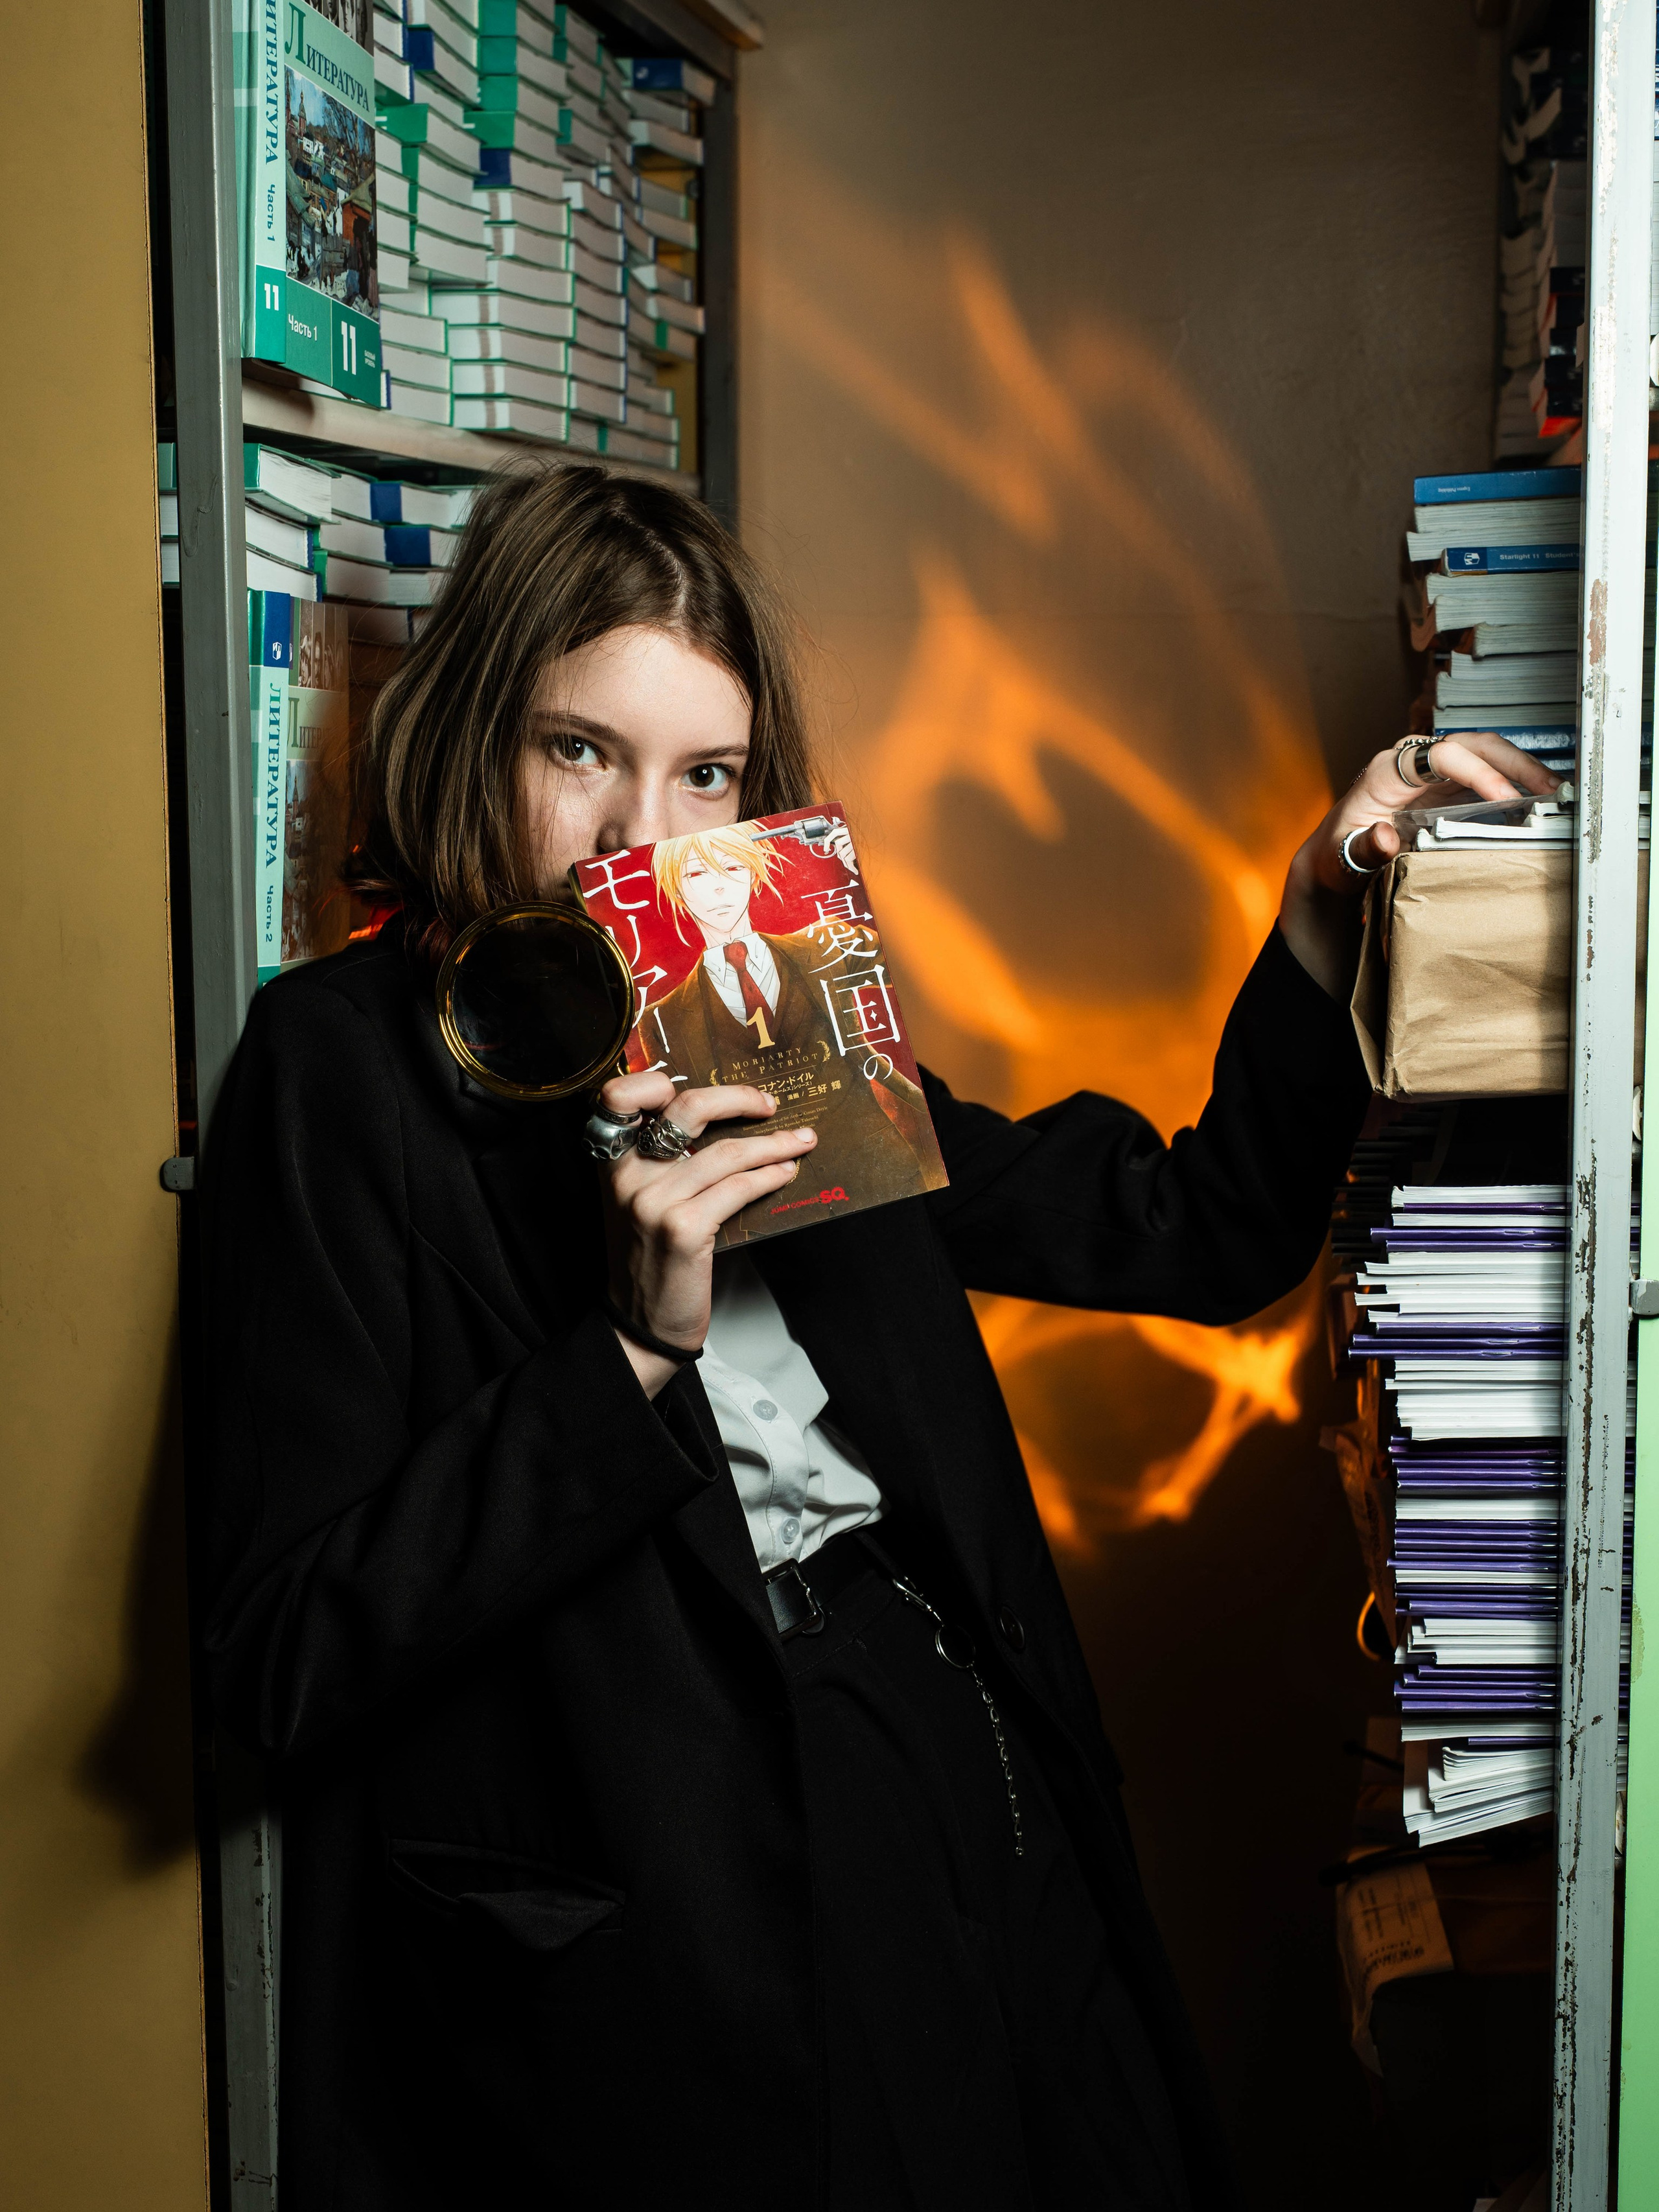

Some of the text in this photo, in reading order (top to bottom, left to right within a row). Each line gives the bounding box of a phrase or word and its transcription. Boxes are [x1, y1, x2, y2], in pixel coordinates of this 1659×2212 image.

[266, 0, 279, 165] ИТЕРАТУРА
[264, 283, 279, 311] 11
[288, 314, 318, 341] Часть 1
[341, 320, 356, 375] 11
[266, 682, 281, 869] ЛИТЕРАТУРА
[266, 933, 272, 942] 2
[583, 849, 689, 1082] モリアー
[801, 879, 901, 1080] 憂国の
[747, 1007, 776, 1049] 1
[722, 1053, 818, 1083] THE PATRIOT
[732, 1047, 802, 1071] MORIARTY
